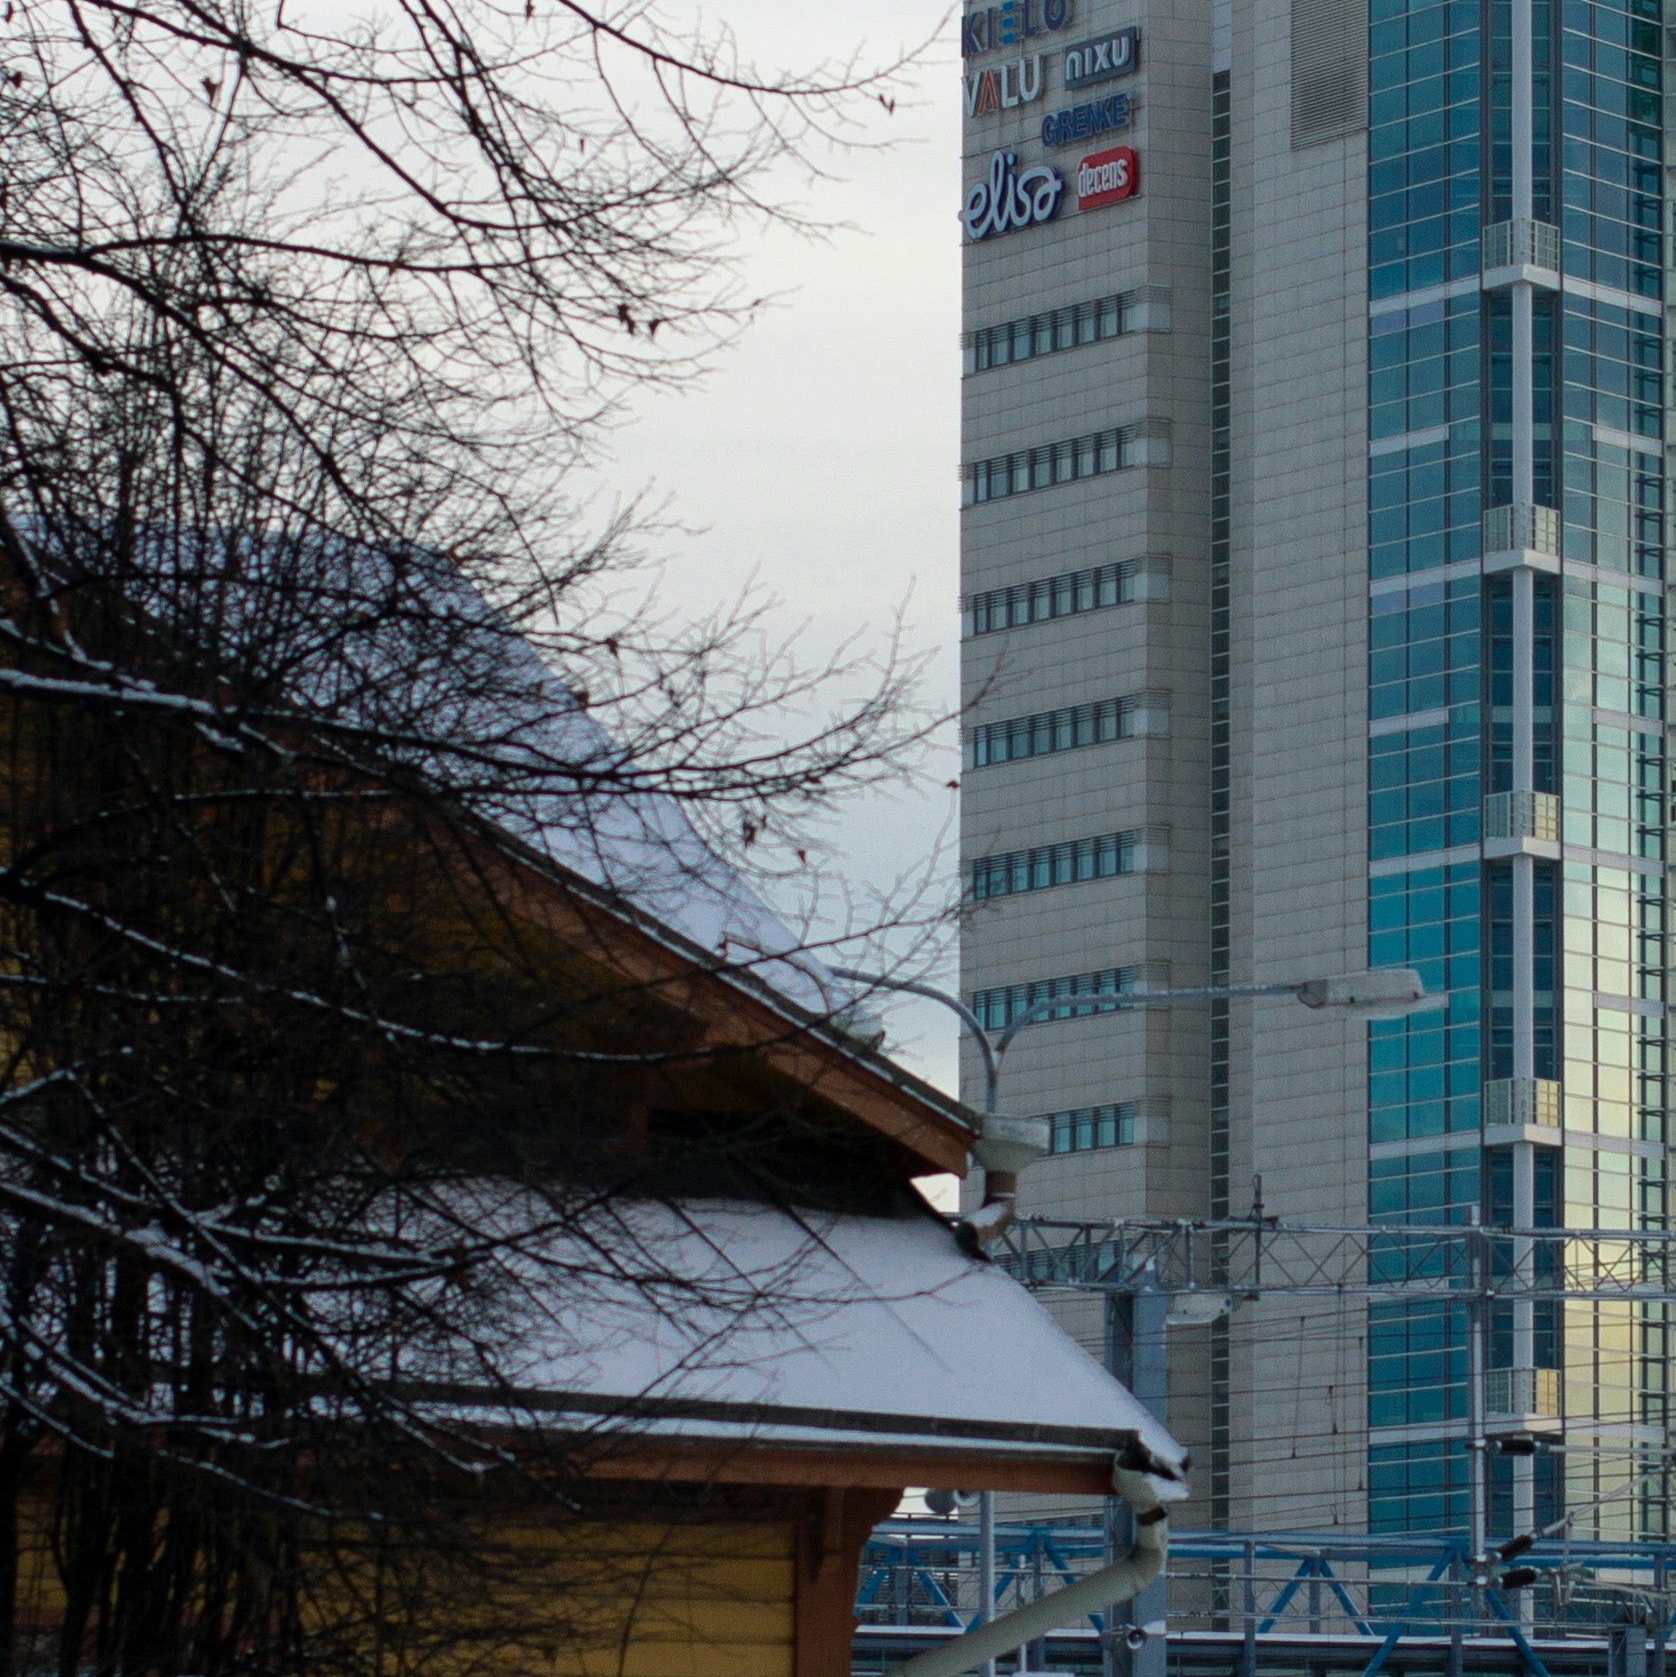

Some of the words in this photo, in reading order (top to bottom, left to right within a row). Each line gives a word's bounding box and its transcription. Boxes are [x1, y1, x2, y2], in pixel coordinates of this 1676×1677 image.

[962, 55, 1041, 117] VALU
[1065, 36, 1131, 82] nixu
[959, 150, 1065, 242] elisa
[1078, 158, 1128, 197] decens
